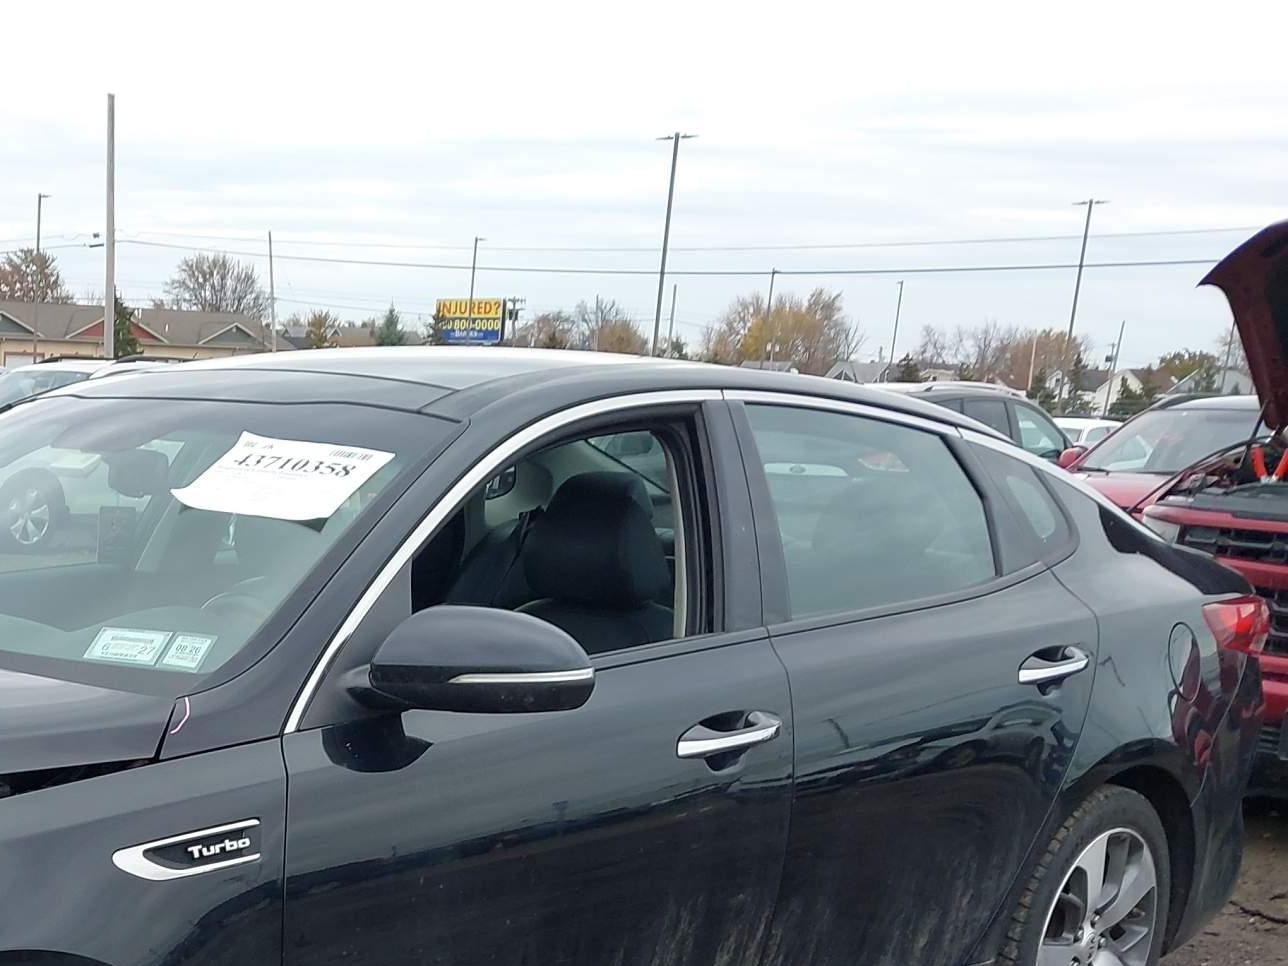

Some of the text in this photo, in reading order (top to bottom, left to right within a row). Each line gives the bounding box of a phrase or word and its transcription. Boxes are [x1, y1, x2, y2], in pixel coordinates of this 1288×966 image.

[438, 300, 501, 315] INJURED?
[234, 453, 357, 478] 43710358
[187, 837, 251, 859] Turbo
